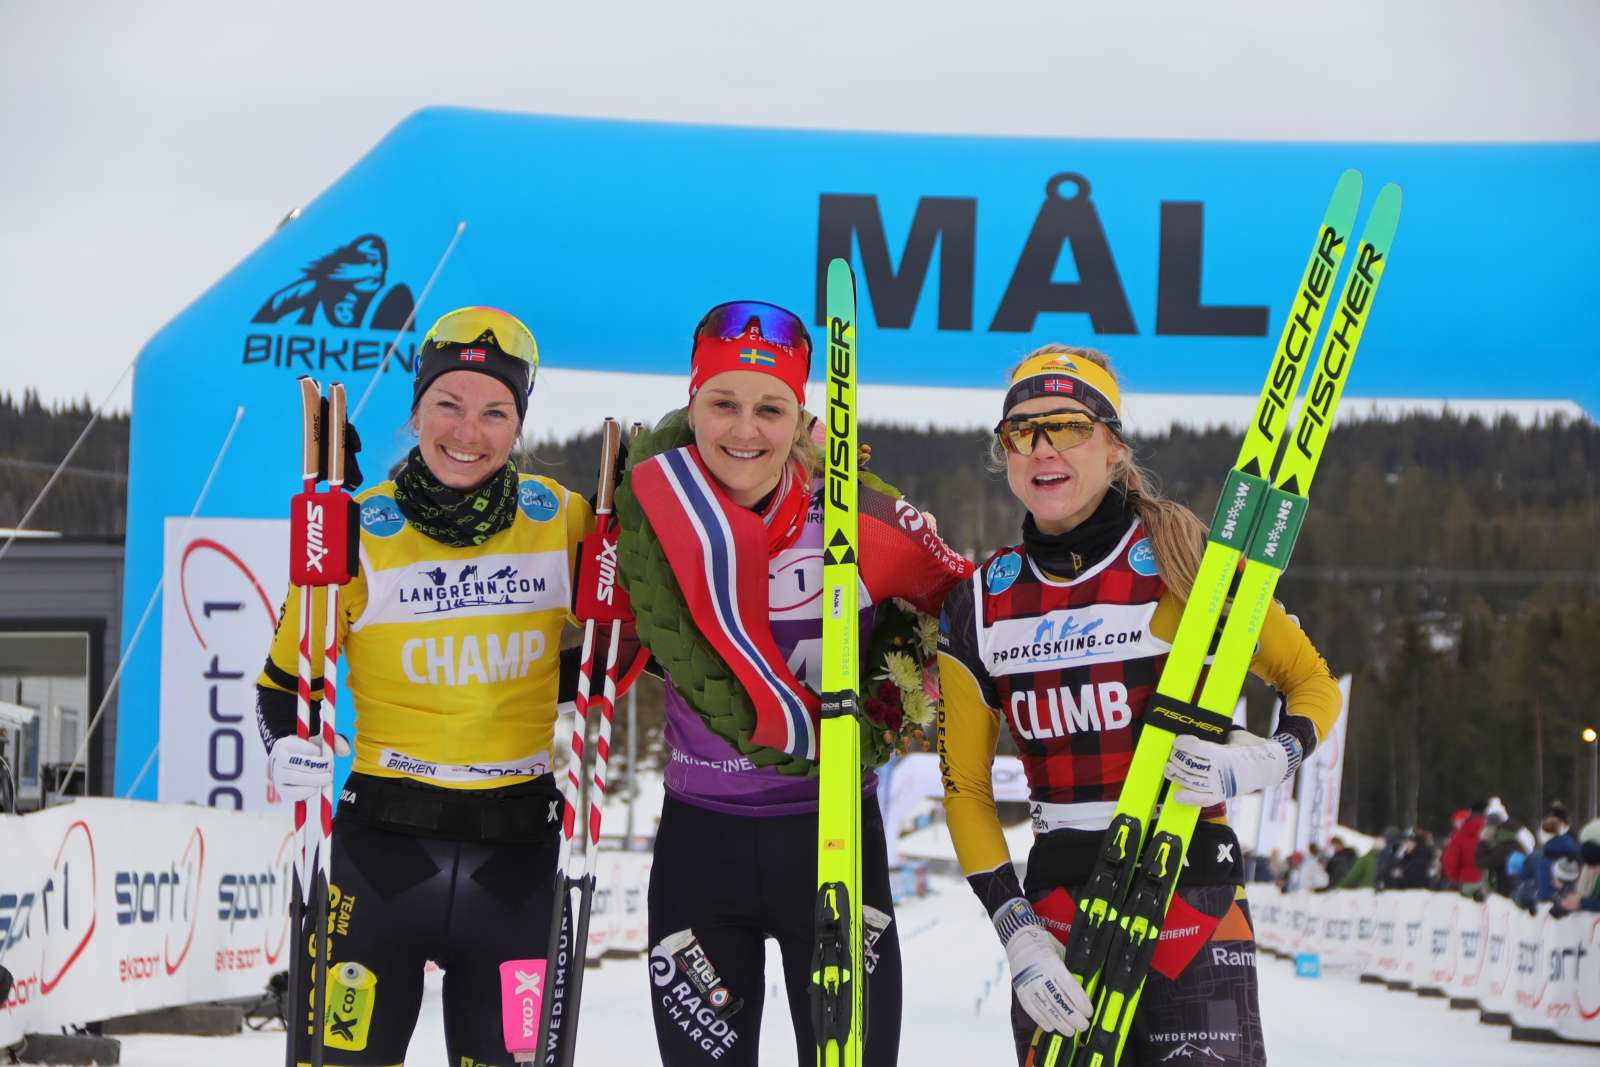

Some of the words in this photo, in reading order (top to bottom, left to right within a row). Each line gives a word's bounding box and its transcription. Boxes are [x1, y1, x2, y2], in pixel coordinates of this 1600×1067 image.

[815, 172, 1271, 337] MÅL
[242, 334, 417, 373] BIRKEN
[1258, 227, 1344, 442] FISCHER
[1296, 243, 1384, 460] FISCHER
[829, 317, 850, 512] FISCHER
[923, 533, 964, 573] CHARGE
[400, 578, 546, 602] LANGRENN.COM
[402, 630, 545, 686] CHAMP
[1011, 682, 1133, 739] CLIMB
[1153, 707, 1223, 735] FISCHER
[387, 758, 437, 776] BIRKEN
[336, 895, 356, 936] TEAM
[684, 944, 721, 989] Fuel
[522, 998, 534, 1038] COXA
[662, 996, 725, 1060] CHARGE
[672, 981, 738, 1048] RAGDE
